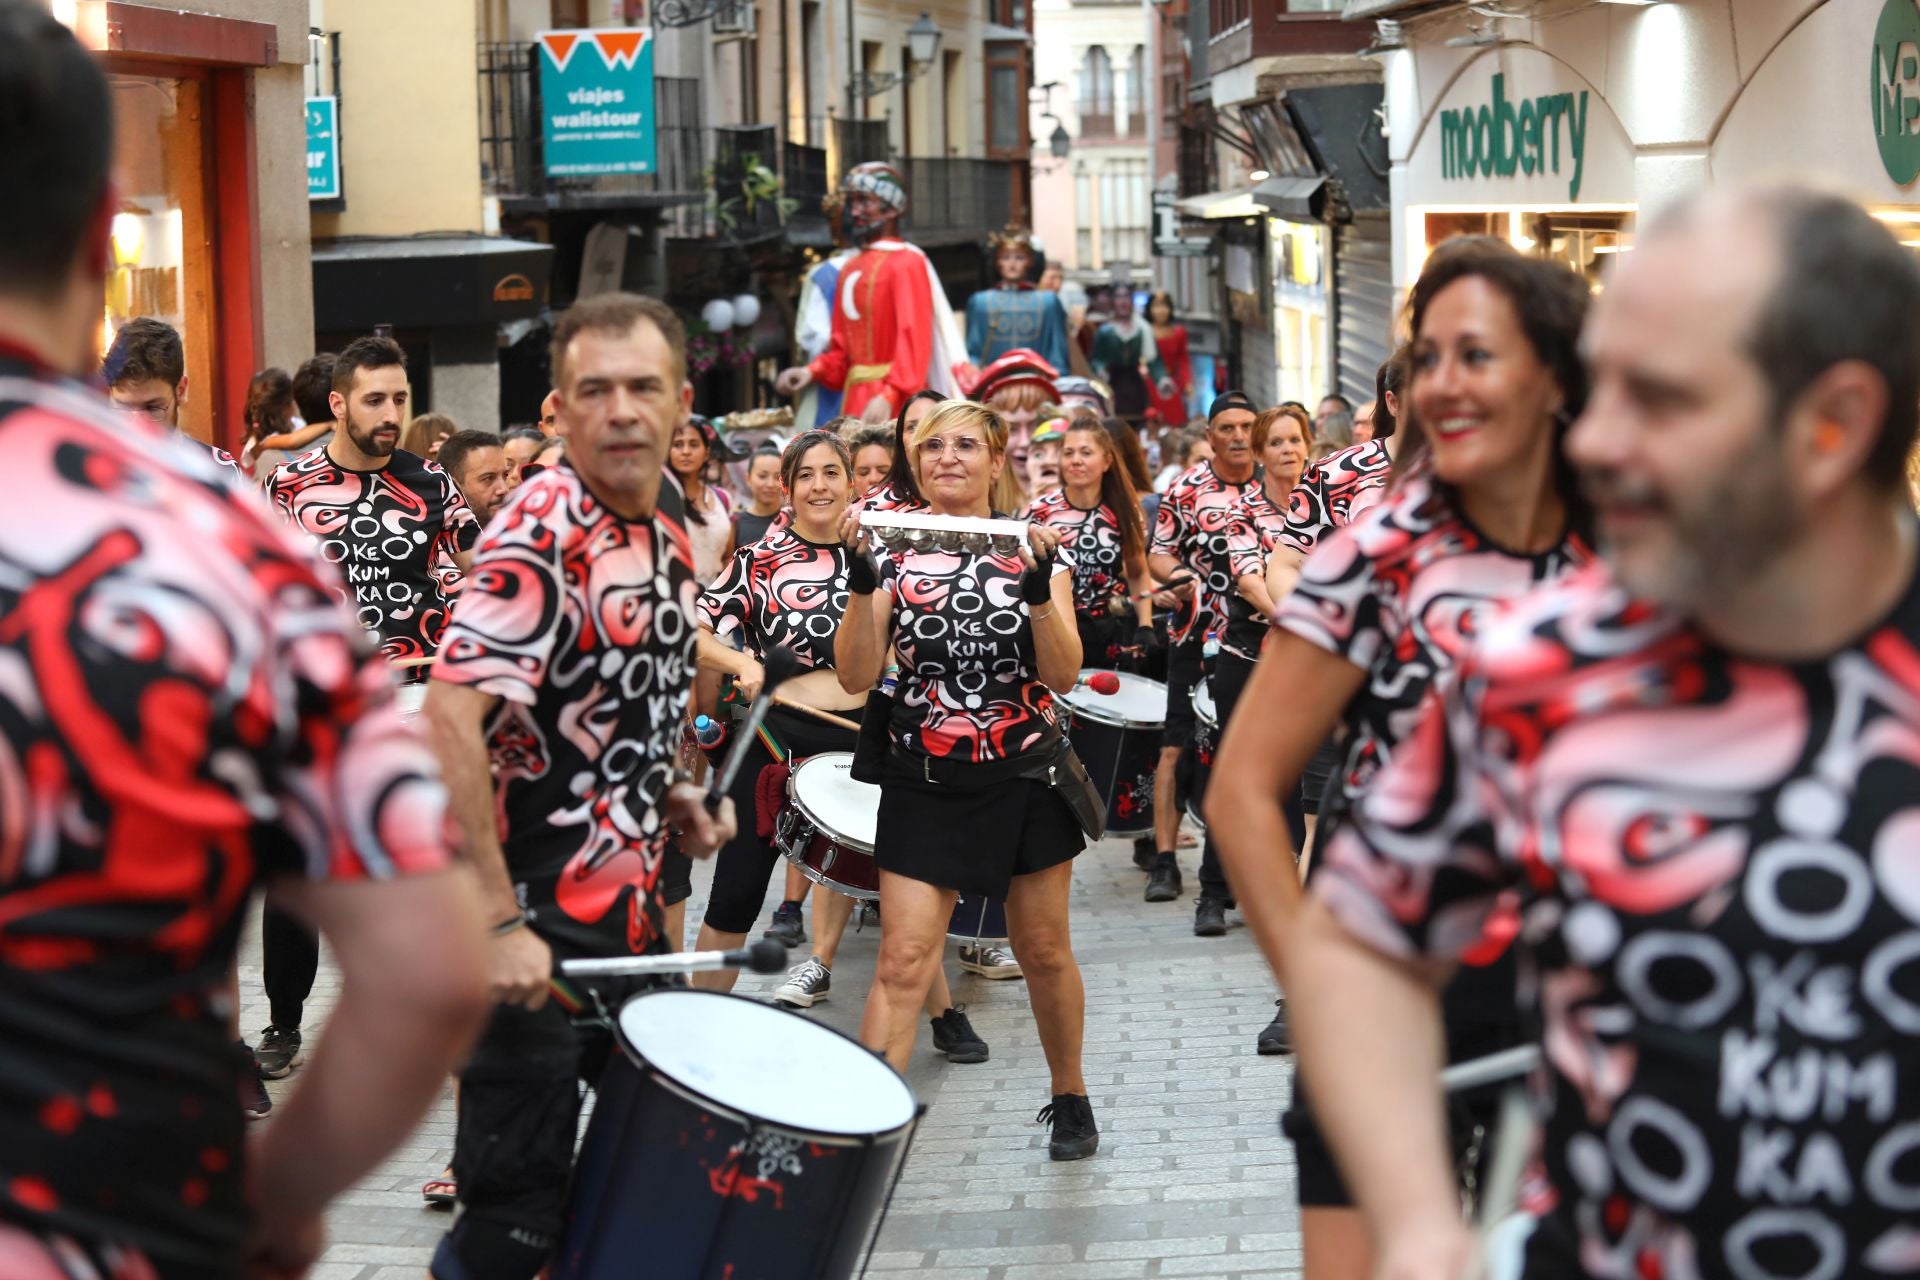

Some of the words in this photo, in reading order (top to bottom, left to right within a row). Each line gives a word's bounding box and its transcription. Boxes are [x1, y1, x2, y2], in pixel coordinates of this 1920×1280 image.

[567, 86, 625, 107] viajes
[551, 110, 642, 128] walistour
[1440, 72, 1589, 202] mooberry
[353, 542, 381, 562] KE
[1079, 551, 1097, 565] KE
[348, 563, 390, 583] KUM
[356, 584, 383, 603] KA
[953, 617, 986, 638] KE
[946, 639, 998, 659] KUM
[1748, 952, 1862, 1041] KE
[1717, 1027, 1898, 1124] KUM
[1737, 1121, 1855, 1206] KA
